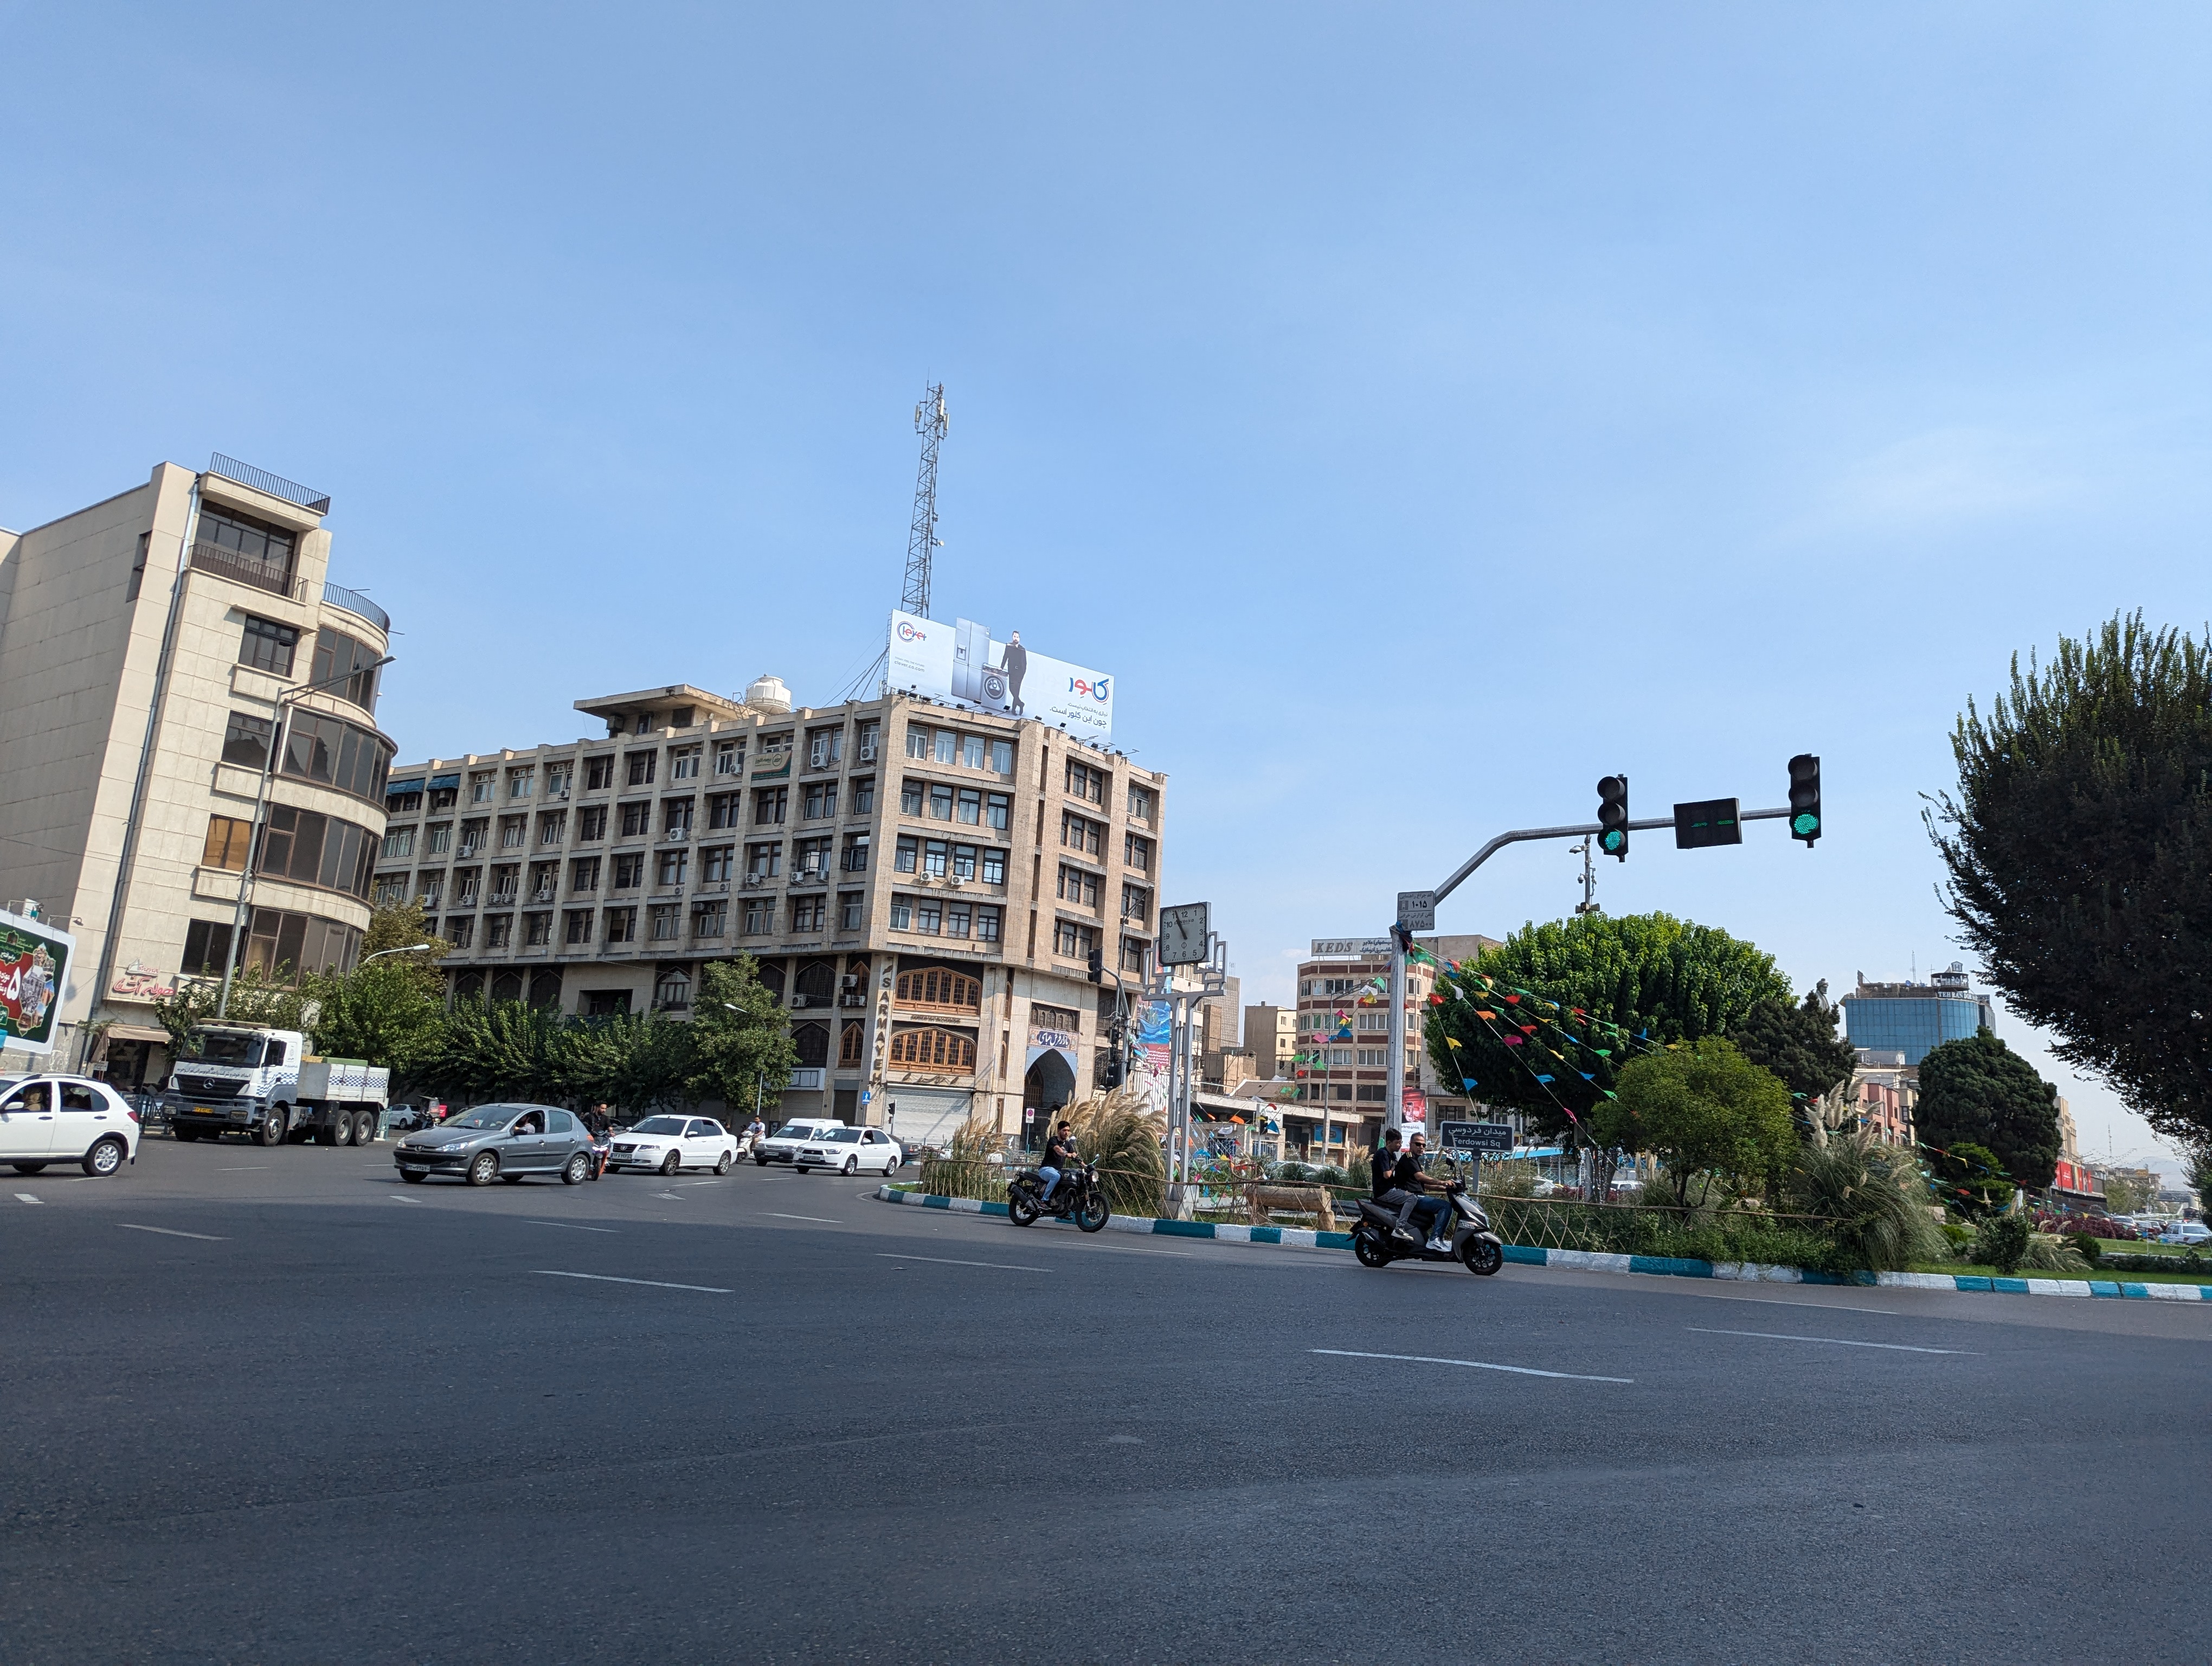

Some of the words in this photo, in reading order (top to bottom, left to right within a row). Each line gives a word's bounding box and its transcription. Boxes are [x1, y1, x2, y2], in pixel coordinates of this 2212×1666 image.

[897, 620, 927, 644] Clever
[1082, 715, 1092, 724] این
[1093, 718, 1107, 729] چون
[1412, 900, 1427, 908] ۱۰۱۵
[1410, 920, 1432, 928] ۸۷۵۰۰
[1315, 942, 1353, 953] KEDS
[7, 966, 21, 1001] ۵
[872, 977, 892, 1084] SARMAYEH
[1448, 1126, 1482, 1136] فردوسی
[1483, 1127, 1507, 1137] میدان
[1454, 1137, 1488, 1146] Ferdowsi
[1490, 1139, 1501, 1149] Sq
